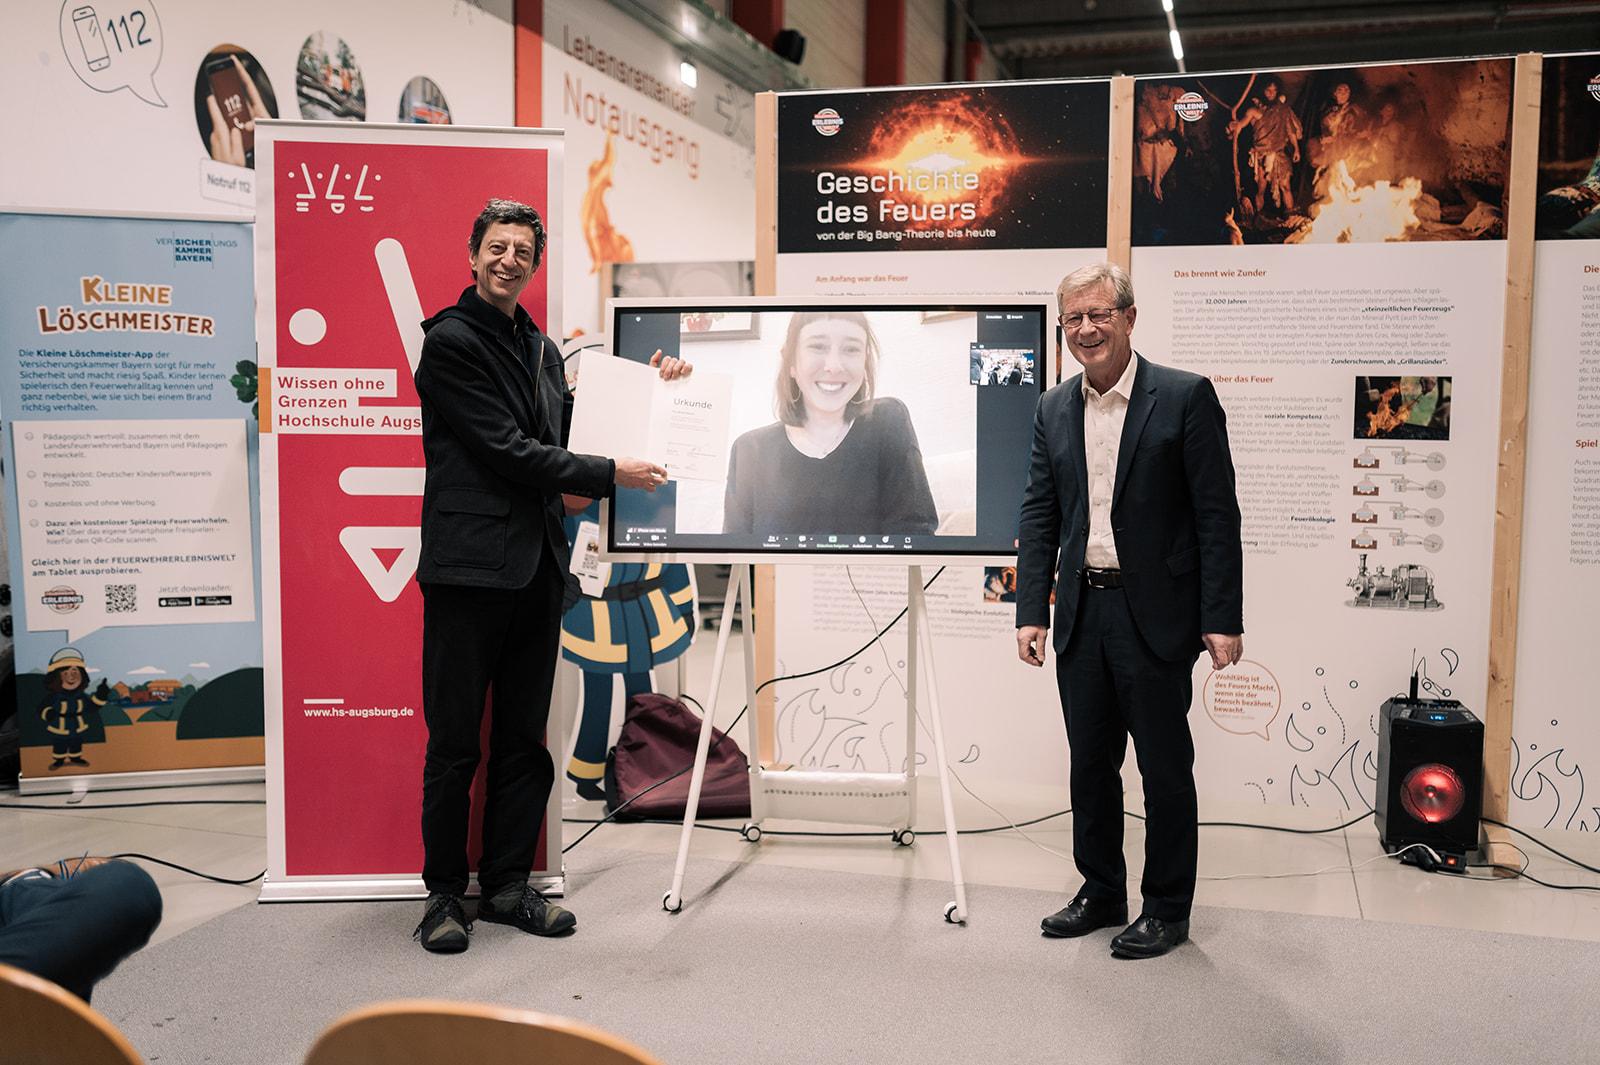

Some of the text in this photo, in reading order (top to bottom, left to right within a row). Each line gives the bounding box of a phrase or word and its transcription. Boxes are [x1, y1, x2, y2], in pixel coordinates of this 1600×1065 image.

[107, 10, 152, 52] 112
[224, 94, 242, 113] 112
[1174, 102, 1208, 111] ERLEBNIS
[563, 71, 699, 180] Notausgang
[207, 174, 252, 194] Notruf 112
[816, 169, 980, 194] Geschichte
[816, 199, 976, 224] des Feuers
[816, 228, 996, 242] von der Big Bang-Theorie bis heute
[1174, 268, 1266, 278] Das brennt wie Zunder
[1584, 265, 1600, 273] Die
[830, 275, 856, 284] Anfang
[69, 350, 152, 360] Löschmeister-App
[20, 360, 118, 370] Versicherungskammer
[121, 361, 151, 370] Bayern
[154, 361, 176, 370] sorgt
[116, 372, 140, 381] riesig
[20, 382, 68, 391] spielerisch
[90, 382, 161, 392] Feuerwehralltag
[278, 376, 385, 390] Wissen ohne
[278, 395, 347, 408] Grenzen
[673, 398, 713, 410] Urkunde
[22, 403, 50, 412] richtig
[278, 414, 375, 428] Hochschule
[1576, 440, 1598, 448] Spiel
[111, 554, 236, 564] FEUERWEHRERLEBNISWELT
[80, 566, 142, 576] ausprobieren.
[1215, 674, 1249, 682] Wohltätig
[1252, 684, 1276, 692] Macht,
[1242, 699, 1273, 708] bezähmt,
[304, 707, 414, 718] www.hs-augsburg.de
